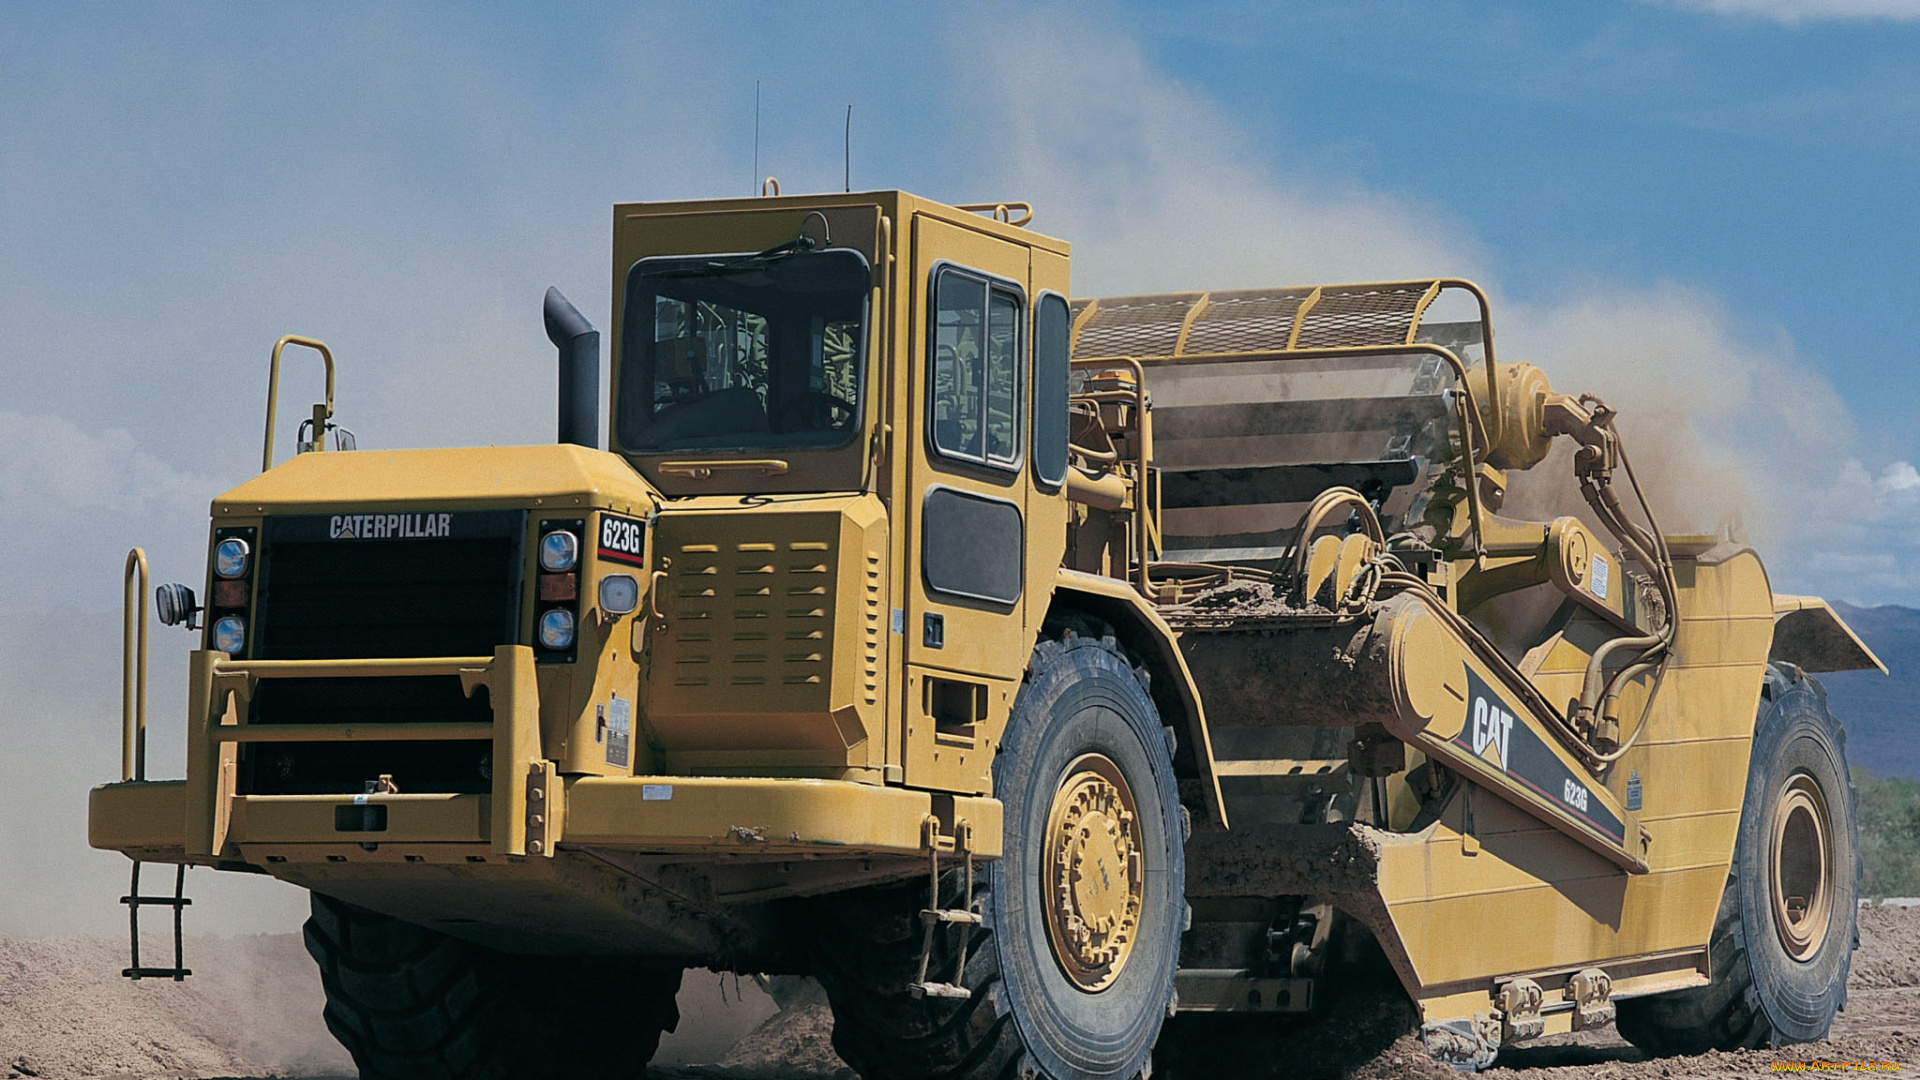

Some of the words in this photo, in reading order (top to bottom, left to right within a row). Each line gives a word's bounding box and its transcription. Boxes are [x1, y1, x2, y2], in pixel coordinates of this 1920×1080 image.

[329, 513, 451, 539] CATERPILLAR
[603, 518, 640, 554] 623G
[1472, 696, 1514, 773] CAT
[1564, 778, 1588, 812] 623G
